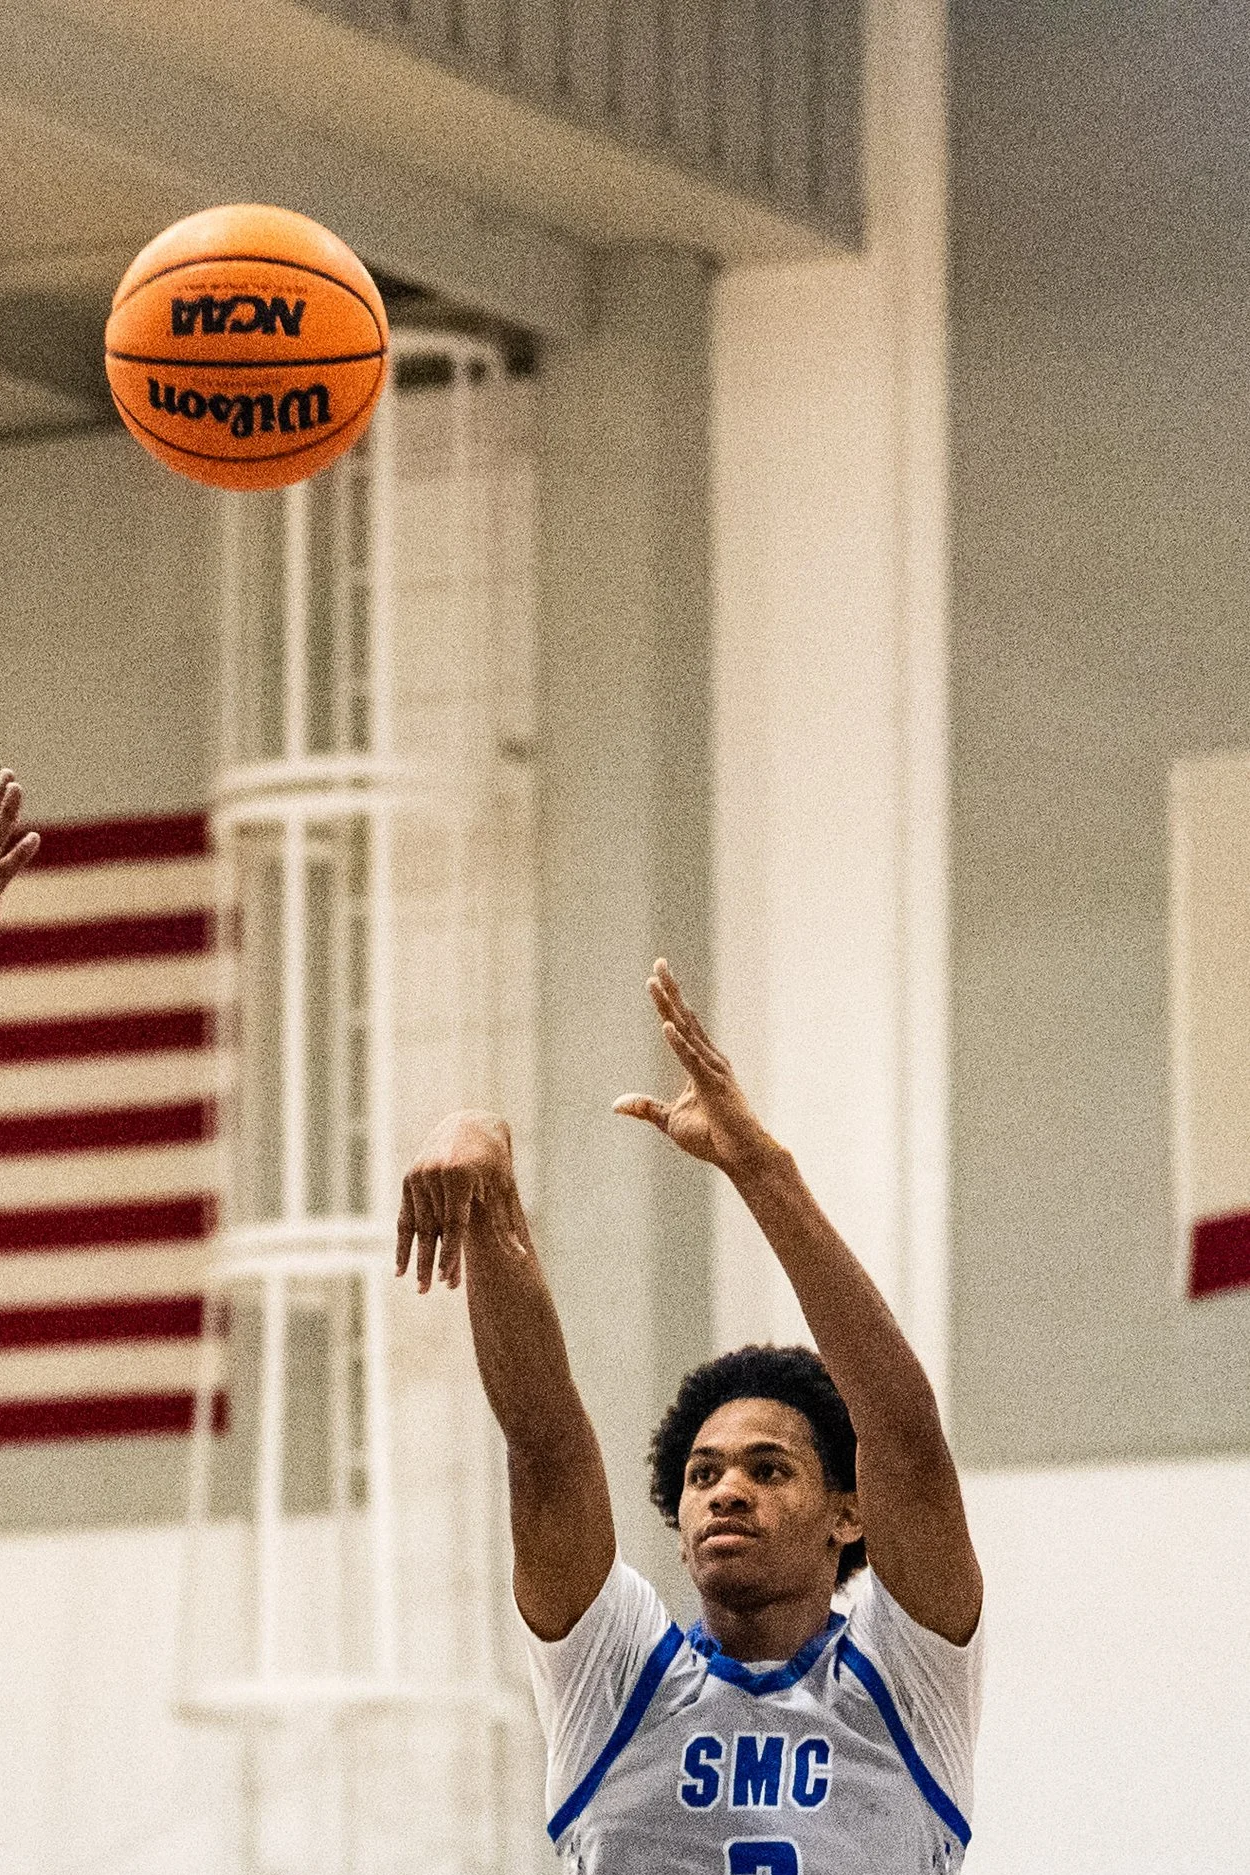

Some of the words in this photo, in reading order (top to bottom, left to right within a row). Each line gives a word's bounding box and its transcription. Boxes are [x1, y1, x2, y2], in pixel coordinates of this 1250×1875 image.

[171, 294, 306, 337] NCAA
[147, 377, 332, 438] Wilson
[679, 1732, 834, 1812] SMC
